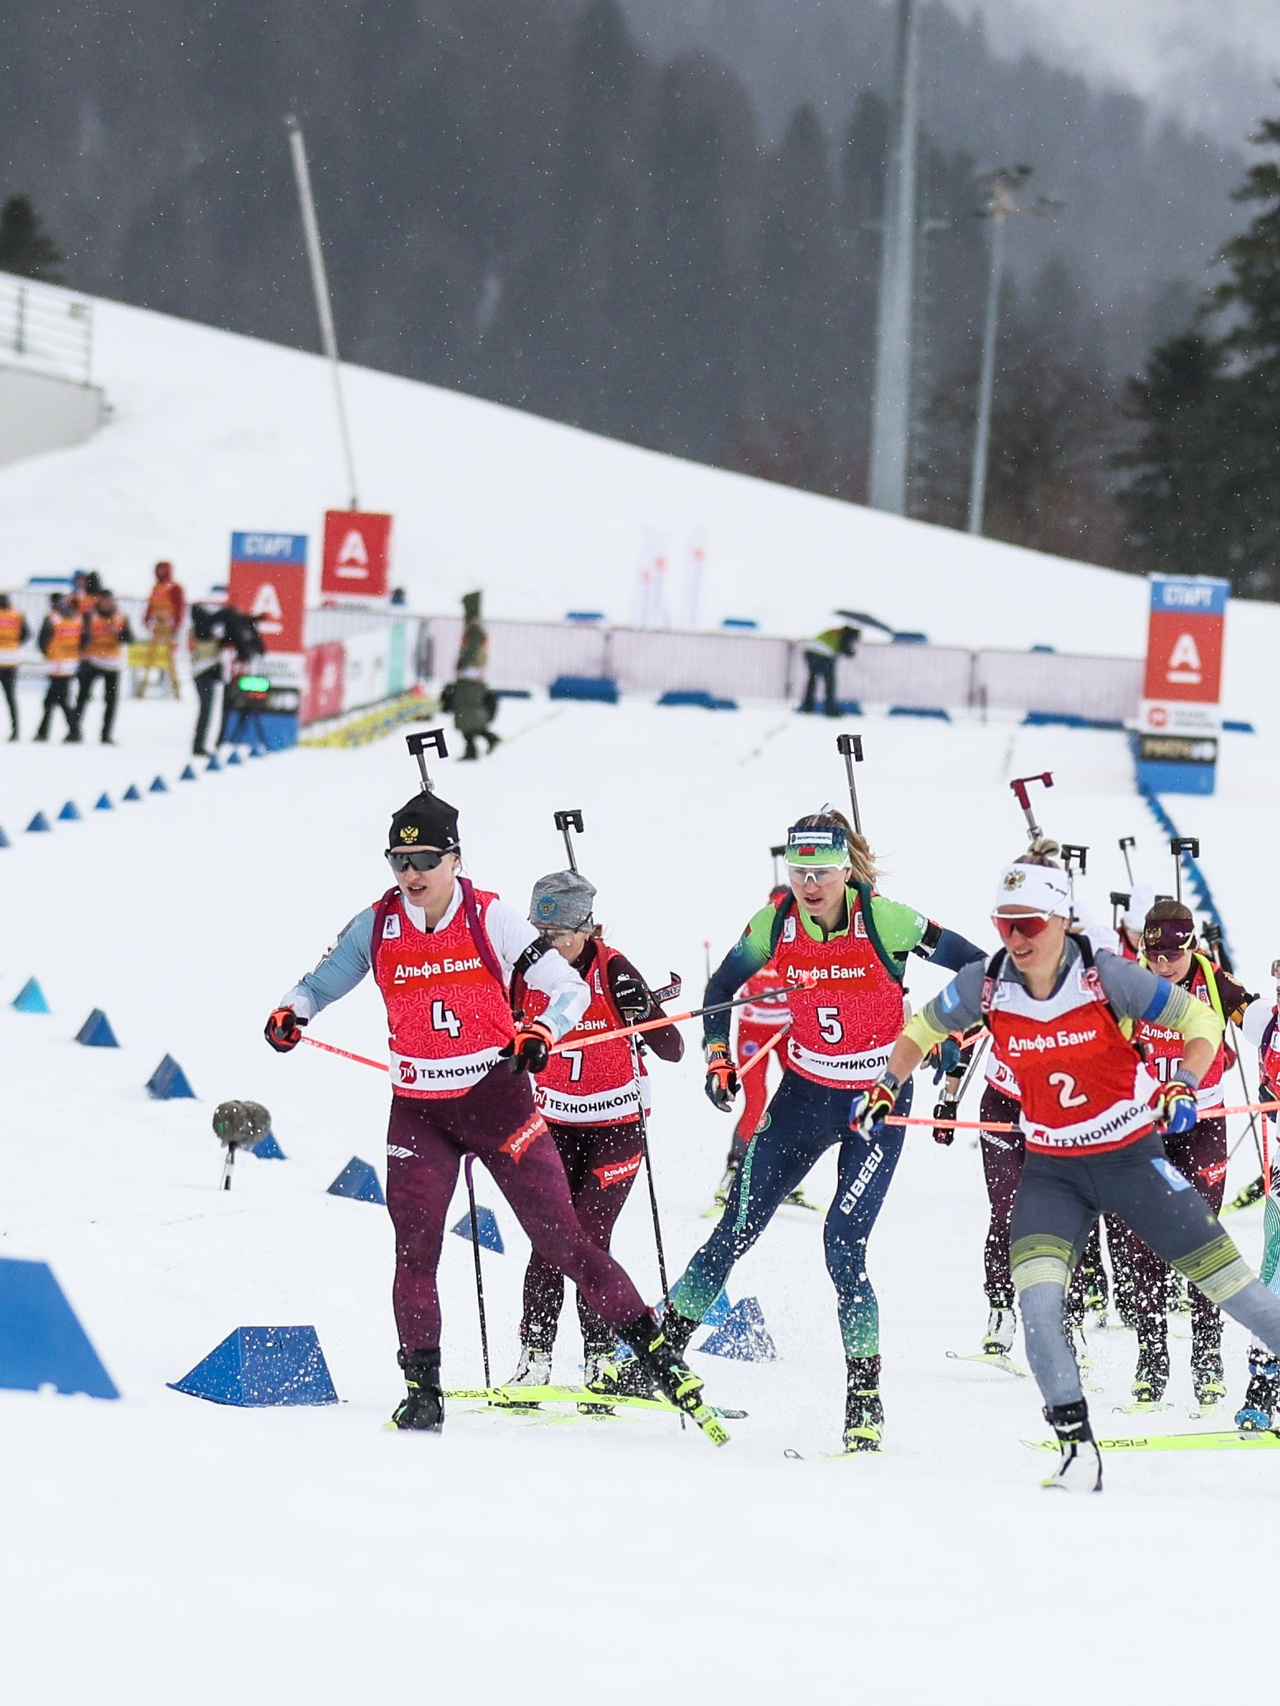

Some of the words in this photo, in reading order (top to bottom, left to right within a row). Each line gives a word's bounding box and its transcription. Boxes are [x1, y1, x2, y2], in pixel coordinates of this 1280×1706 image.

[394, 962, 442, 984] Альфа
[443, 957, 483, 974] Банк
[786, 964, 828, 983] Алфа
[830, 965, 867, 979] Банк
[432, 1000, 461, 1038] 4
[575, 1018, 608, 1031] Банк
[817, 1006, 843, 1044] 5
[1008, 1035, 1056, 1057] Альфа
[1057, 1030, 1098, 1047] Банк
[1140, 1024, 1181, 1042] Альфа
[420, 1058, 498, 1079] ТЕХНОНИК
[561, 1050, 583, 1082] 7
[549, 1090, 641, 1113] ТЕХНОНИКОЛЬ
[1048, 1071, 1089, 1109] 2
[510, 1127, 533, 1152] Альфа
